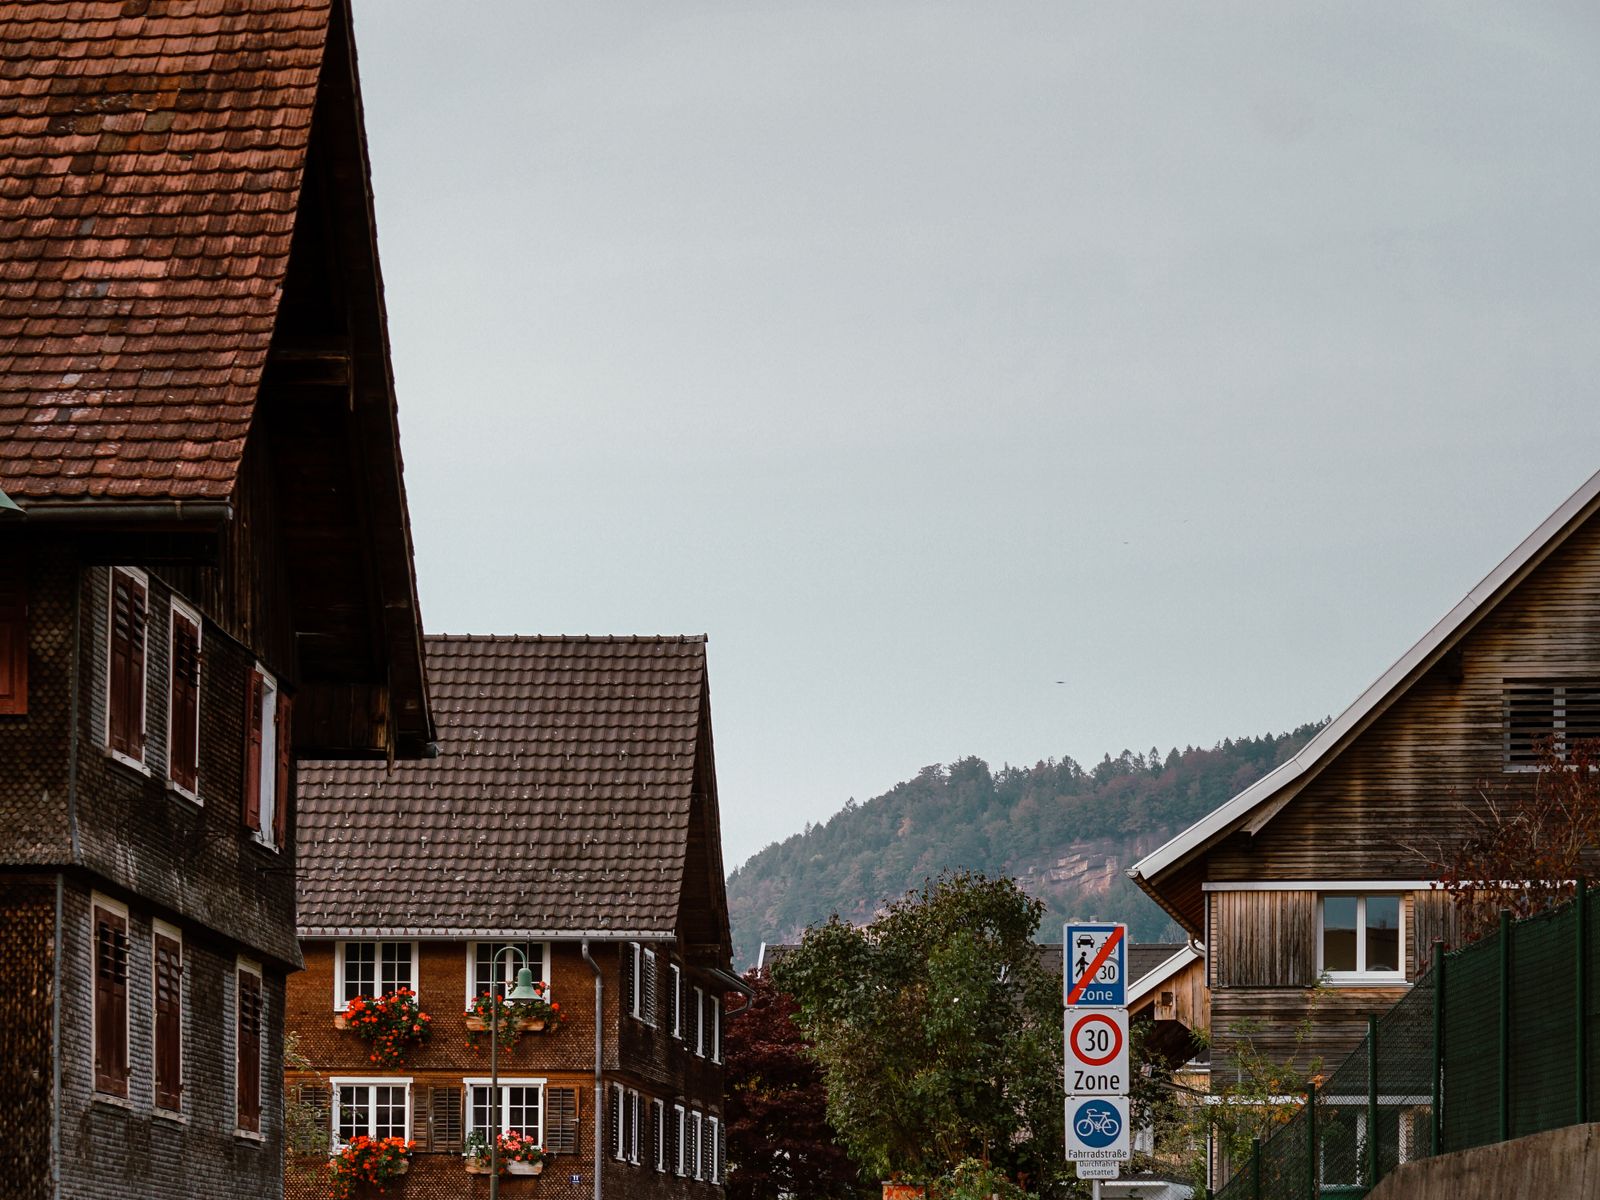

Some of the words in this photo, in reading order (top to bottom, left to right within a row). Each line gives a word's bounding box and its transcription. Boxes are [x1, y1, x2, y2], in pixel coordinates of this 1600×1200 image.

[1100, 965, 1115, 980] 30
[1079, 987, 1113, 1001] Zone
[1085, 1029, 1108, 1051] 30
[1074, 1070, 1120, 1090] Zone
[1068, 1149, 1127, 1158] Fahrradstraße
[1082, 1169, 1114, 1177] gestattet
